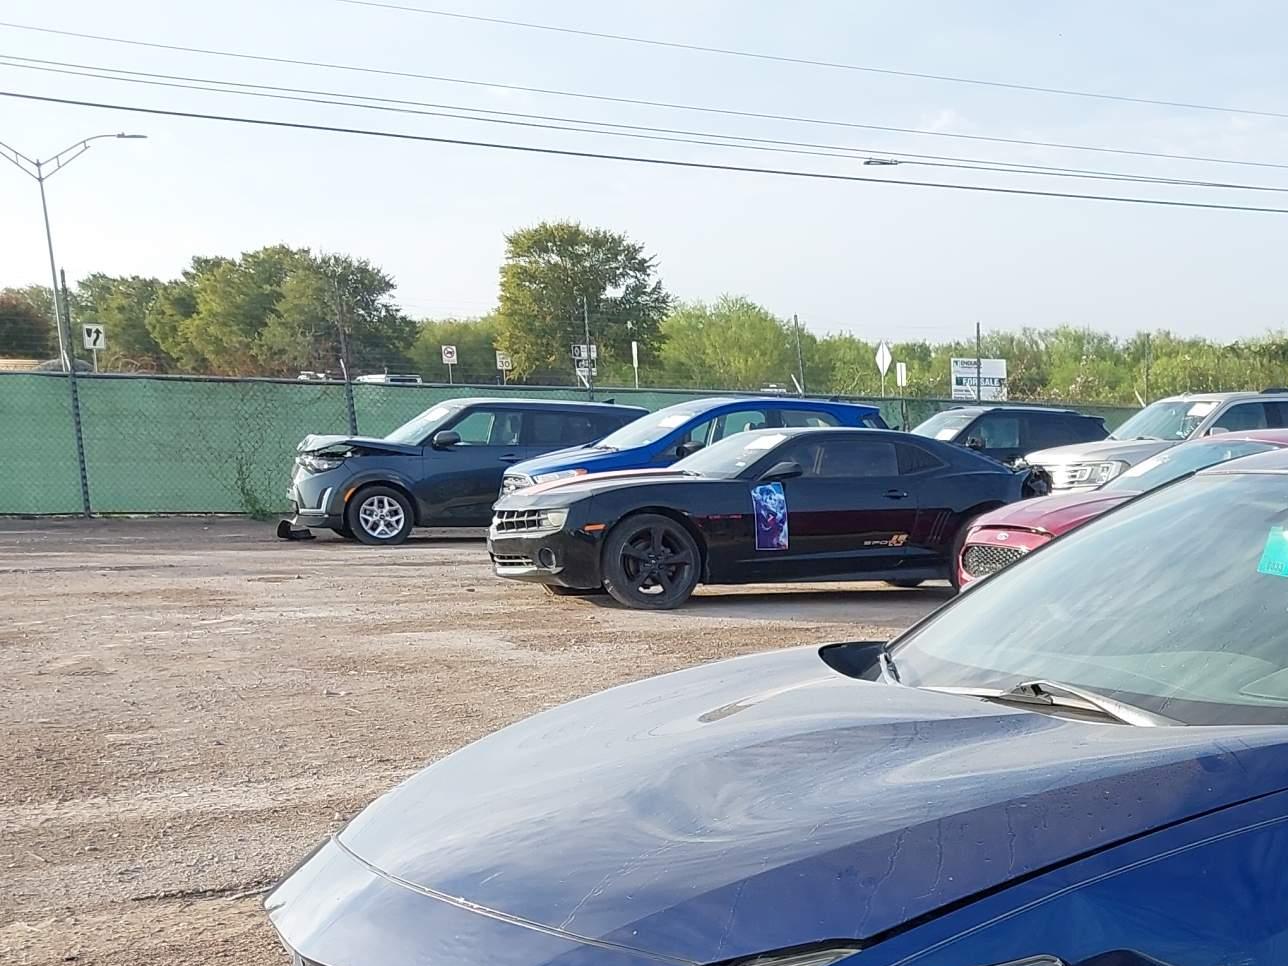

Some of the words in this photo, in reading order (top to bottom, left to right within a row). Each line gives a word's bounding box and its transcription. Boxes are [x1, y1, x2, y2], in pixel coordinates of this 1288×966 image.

[498, 360, 510, 368] 30
[962, 378, 977, 386] FOR
[980, 378, 999, 387] SALE
